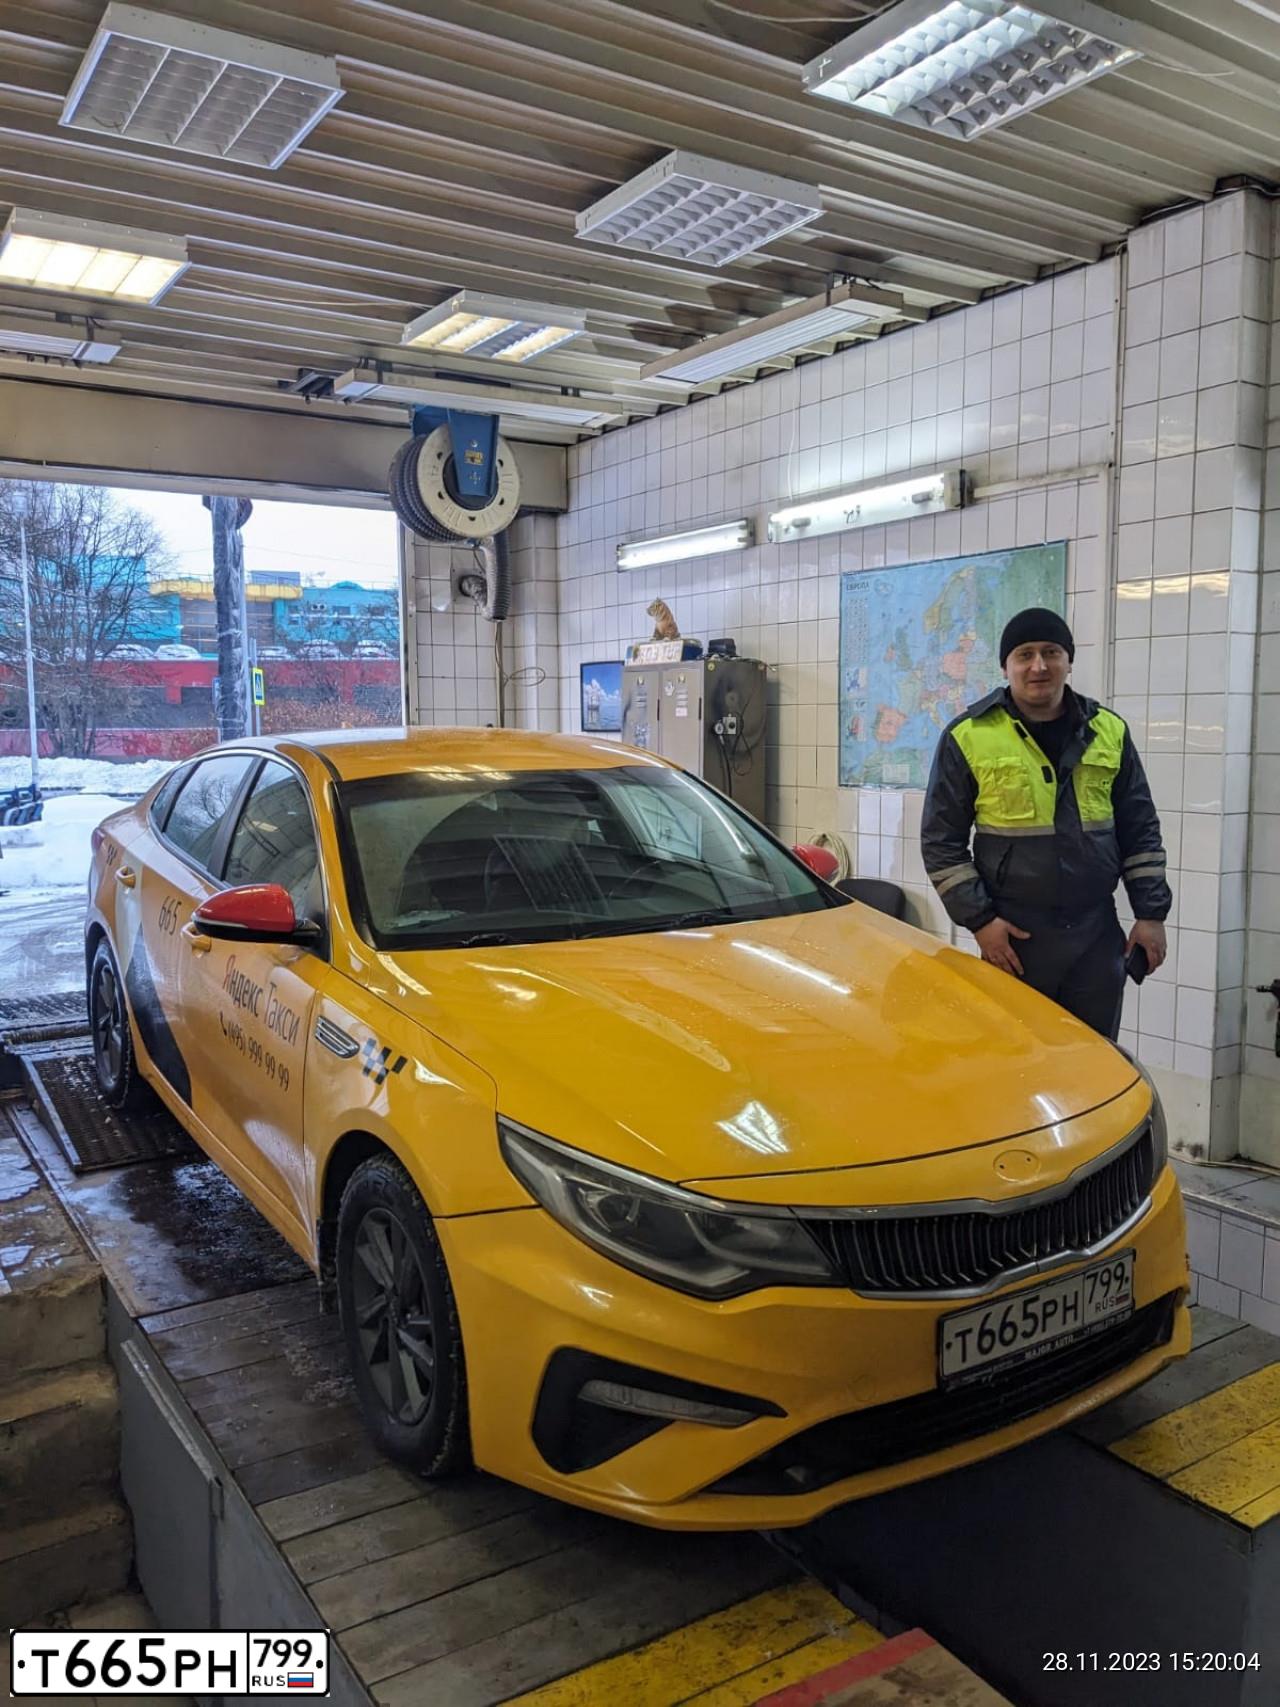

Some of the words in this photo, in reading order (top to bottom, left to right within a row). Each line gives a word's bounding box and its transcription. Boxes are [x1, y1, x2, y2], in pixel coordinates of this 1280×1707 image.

[158, 895, 182, 936] 665
[222, 954, 263, 1018] Яндекс
[264, 981, 300, 1047] Такси
[227, 1020, 246, 1056] (495)
[248, 1035, 262, 1068] 999
[264, 1051, 276, 1079] 99
[278, 1062, 290, 1092] 99
[954, 1290, 1079, 1364] Т665РН
[1086, 1261, 1126, 1305] 799
[1095, 1295, 1116, 1313] RUS
